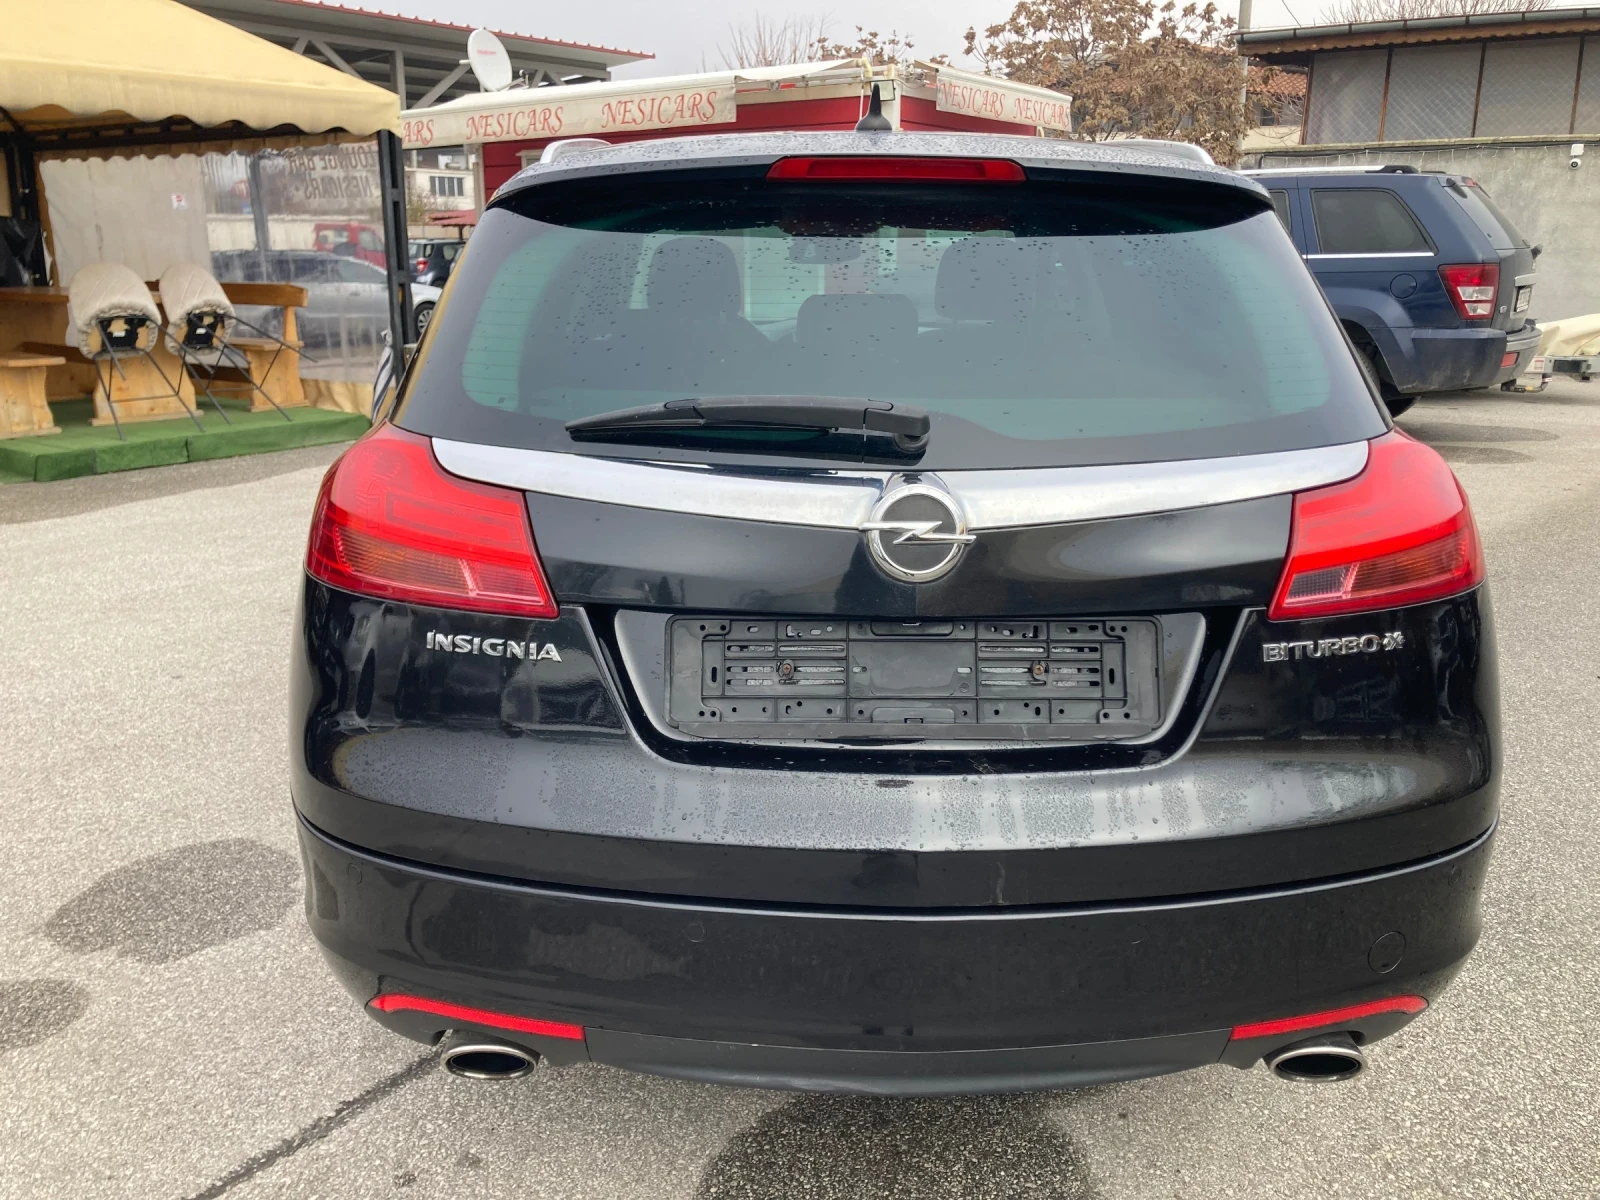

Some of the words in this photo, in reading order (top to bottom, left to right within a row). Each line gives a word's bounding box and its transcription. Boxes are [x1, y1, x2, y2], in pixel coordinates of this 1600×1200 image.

[466, 106, 563, 140] NESICARS
[601, 91, 718, 129] NESICARS
[938, 83, 1005, 118] NESICARS
[1013, 97, 1070, 128] NESICARS
[426, 630, 563, 663] INSIGNIA
[1262, 634, 1381, 662] BITURBO
